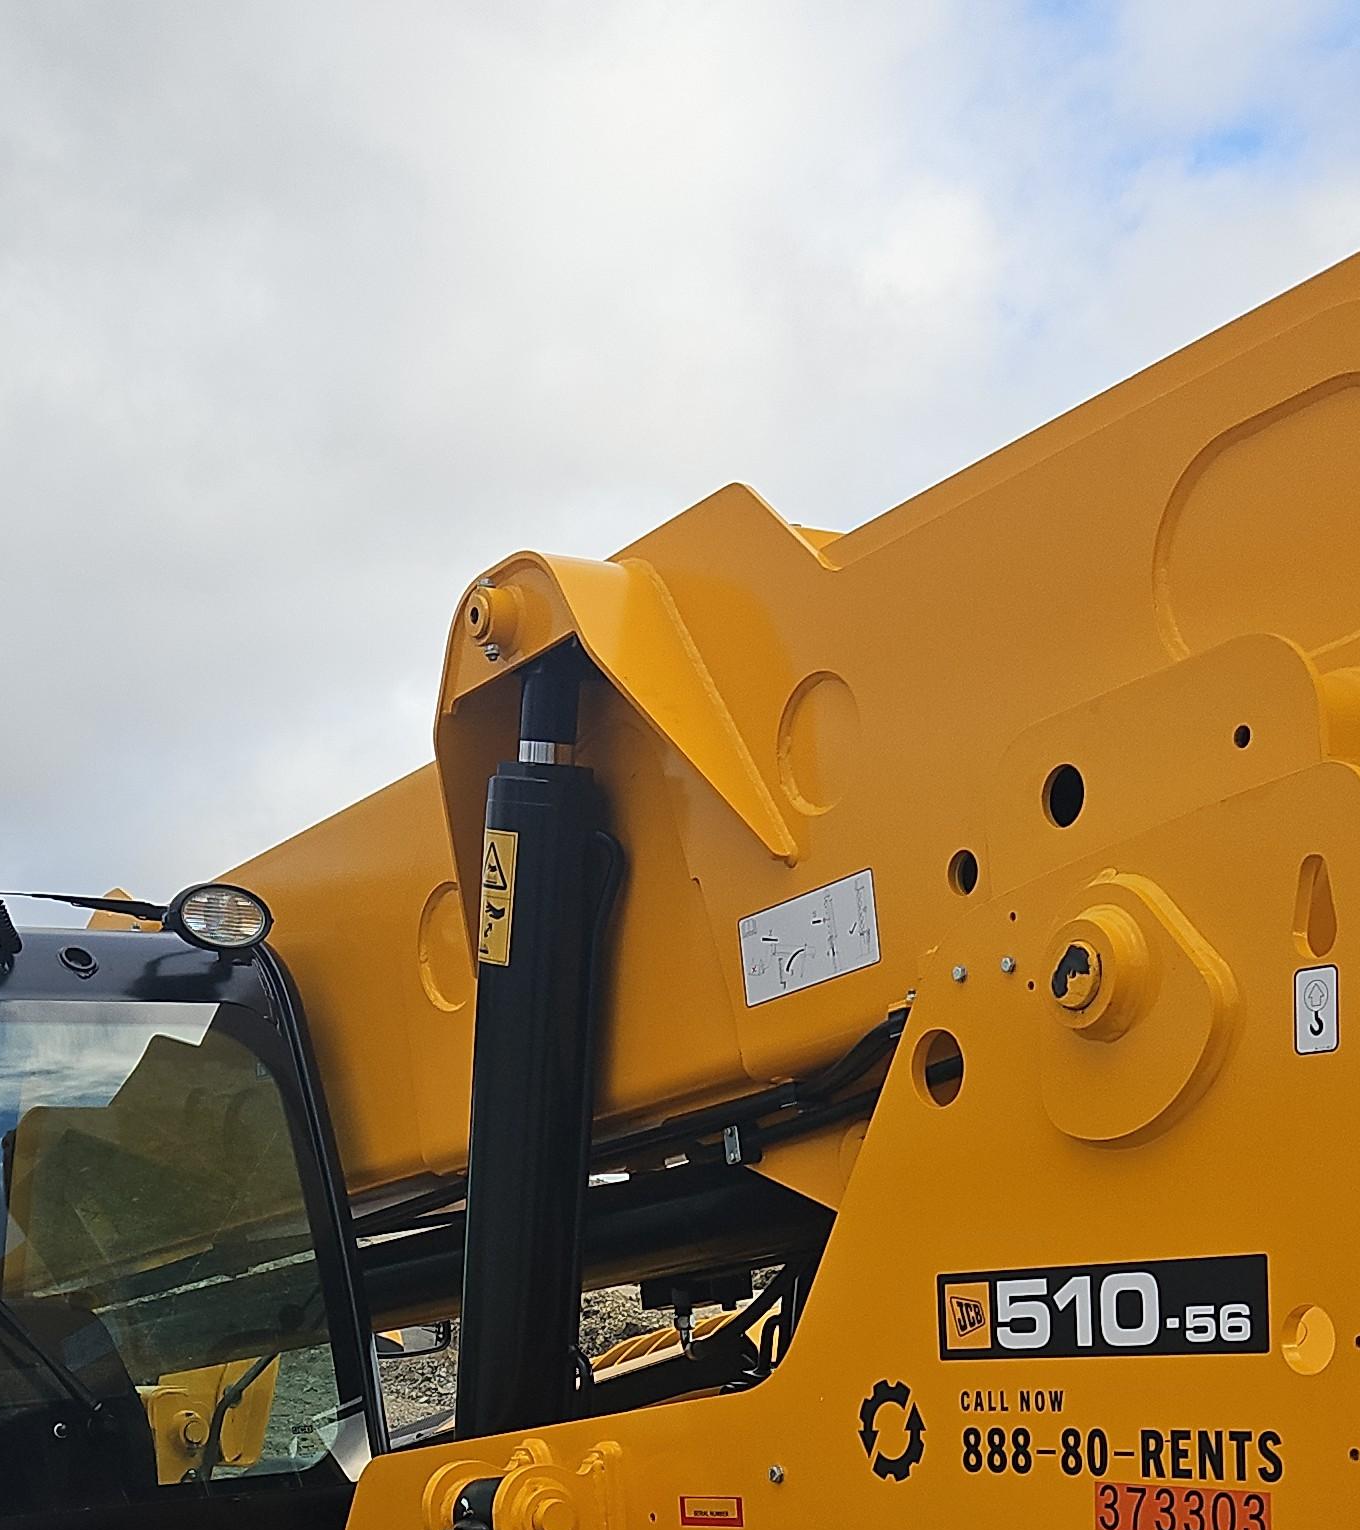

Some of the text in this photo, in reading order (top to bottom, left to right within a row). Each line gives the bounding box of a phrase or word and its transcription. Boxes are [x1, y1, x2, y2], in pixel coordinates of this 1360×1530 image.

[956, 1300, 984, 1333] JCB
[996, 1271, 1252, 1350] 510-56
[960, 1390, 1064, 1413] CALL NOW
[962, 1426, 1284, 1484] 888-80-RENTS
